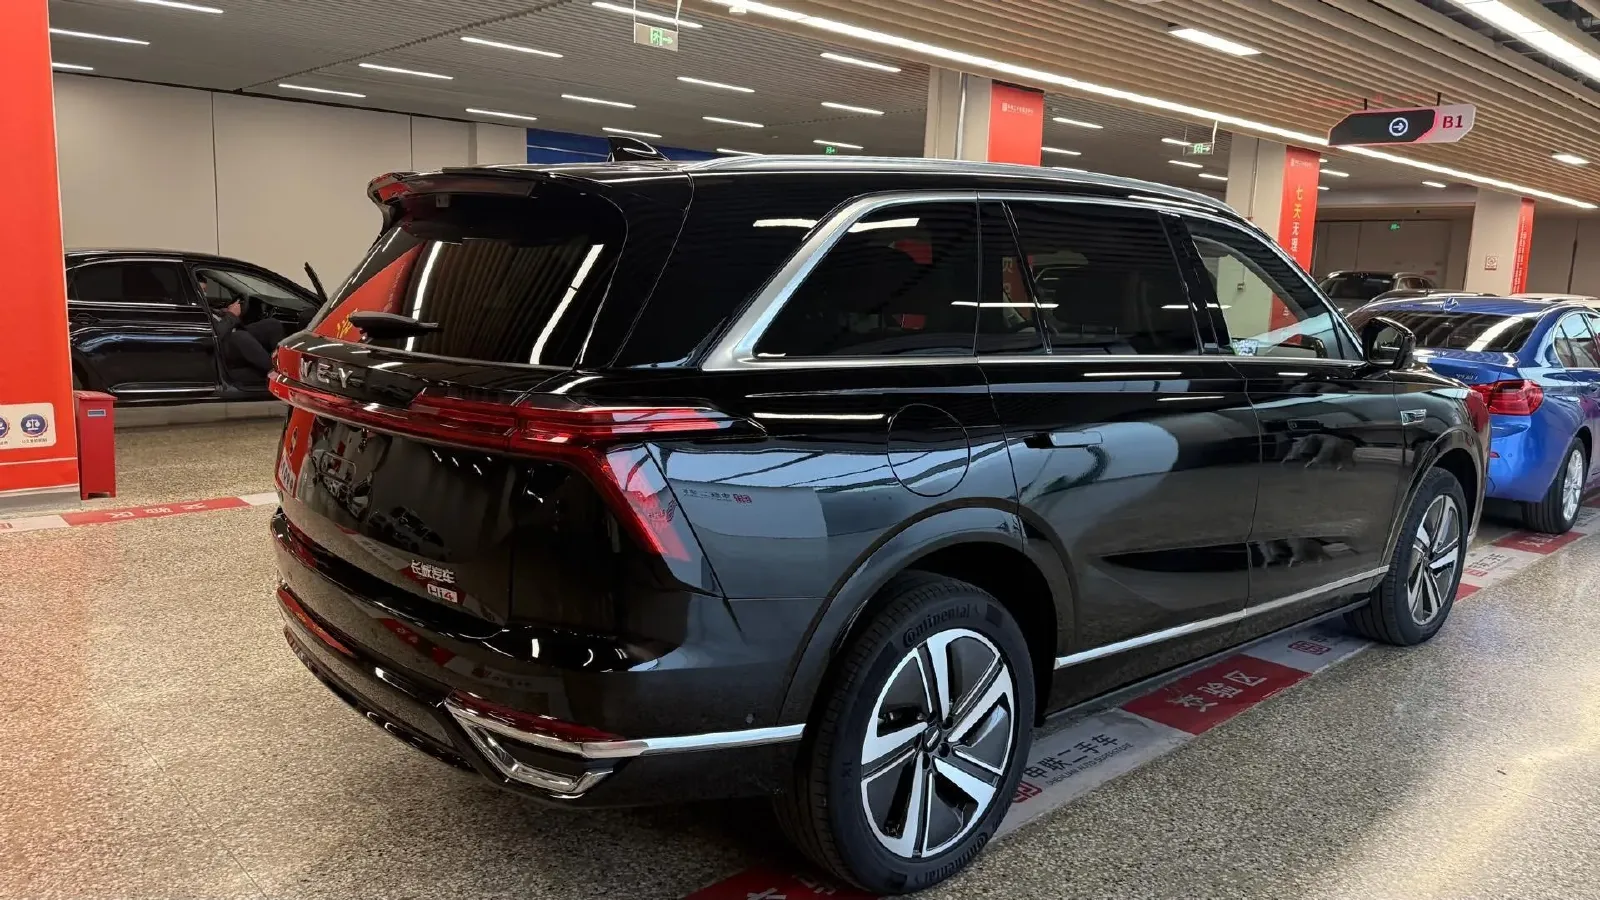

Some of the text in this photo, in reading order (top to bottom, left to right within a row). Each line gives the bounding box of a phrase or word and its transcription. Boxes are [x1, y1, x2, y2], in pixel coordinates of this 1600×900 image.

[1443, 115, 1463, 129] B1
[300, 357, 353, 389] WEY
[410, 559, 456, 584] 长城汽车
[427, 583, 458, 603] Hi4
[903, 603, 970, 648] Continental
[1164, 669, 1268, 713] 交验区
[1023, 734, 1118, 779] 申联二手车
